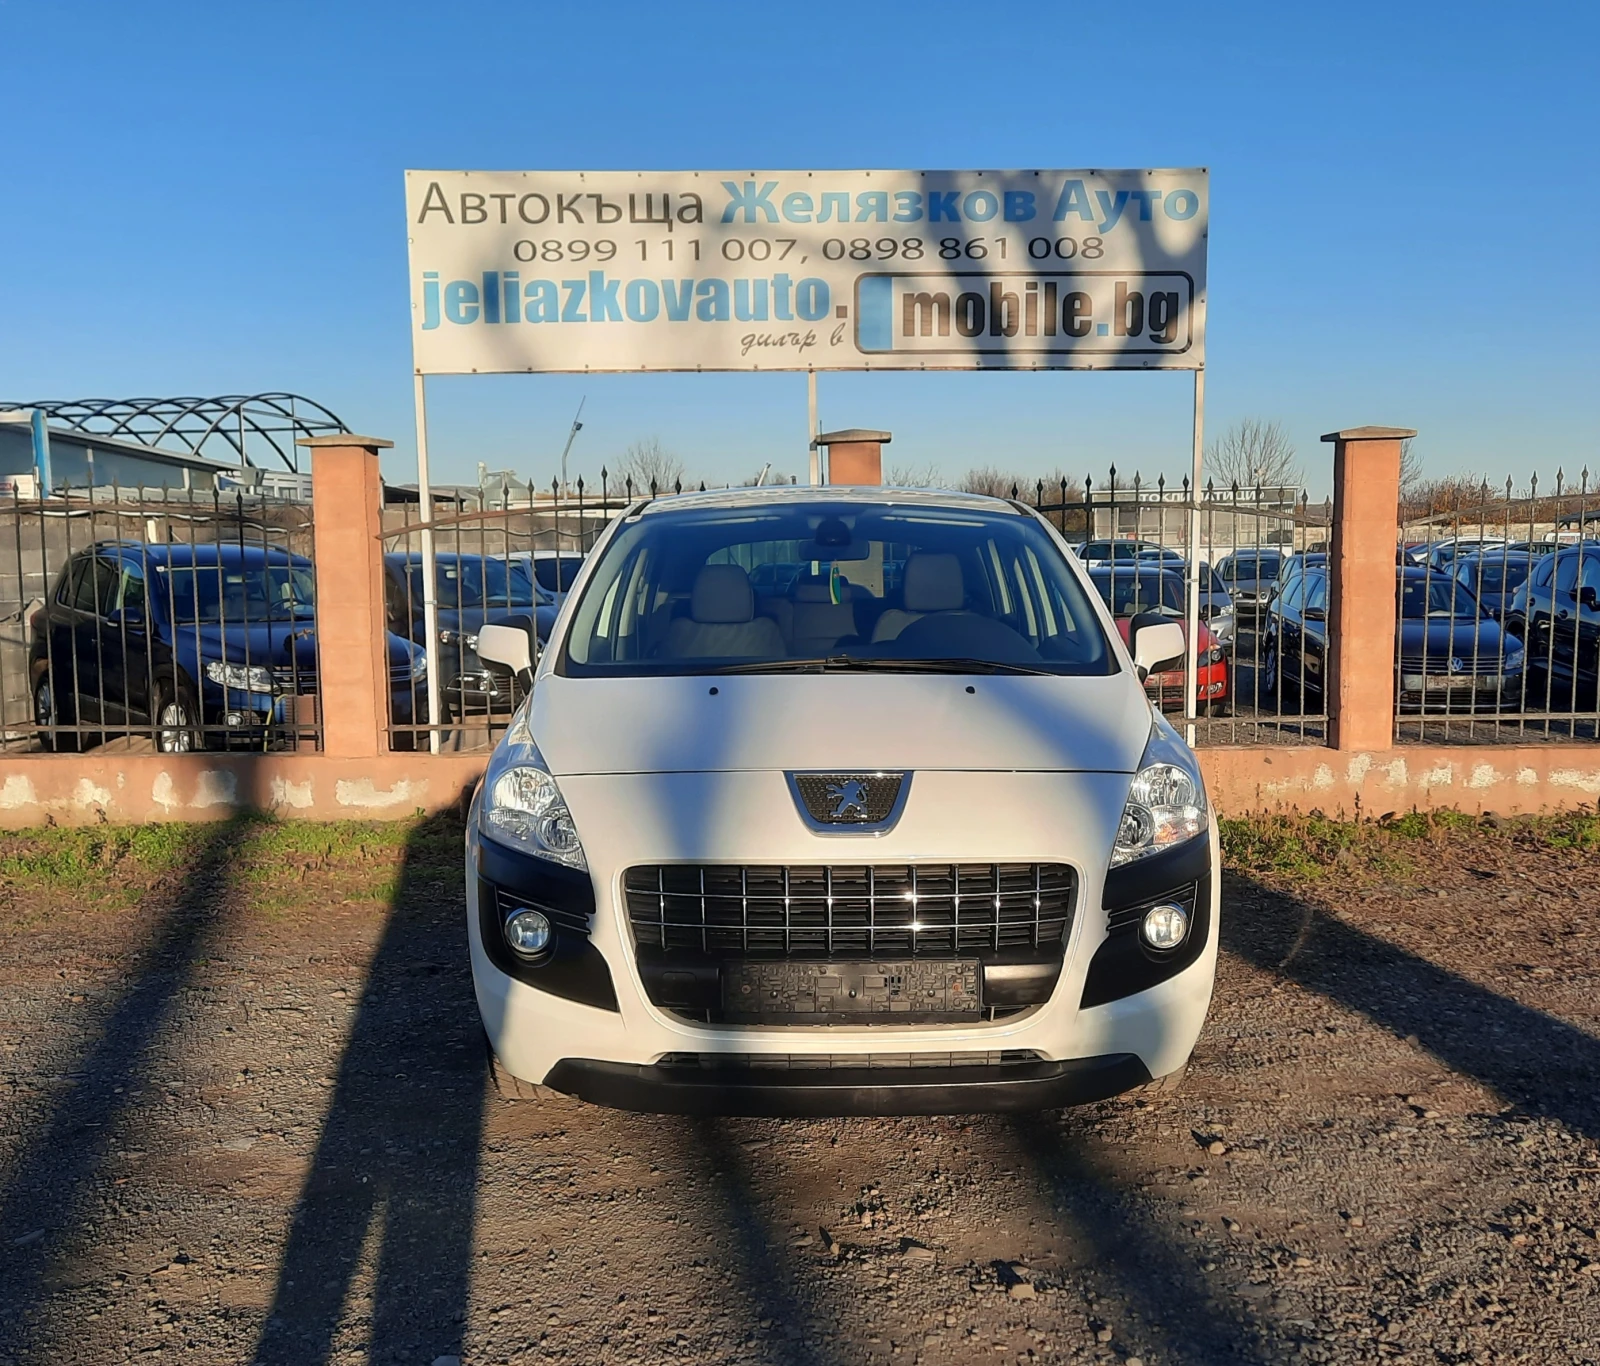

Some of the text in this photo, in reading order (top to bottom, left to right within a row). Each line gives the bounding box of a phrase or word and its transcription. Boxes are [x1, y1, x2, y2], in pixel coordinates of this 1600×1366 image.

[417, 179, 1200, 234] Автокъща Желязков Ауто
[513, 237, 1105, 264] 0899 111 007, 0898 861 008
[902, 281, 1180, 344] mobile.bg
[741, 329, 817, 356] дилър
[1139, 490, 1256, 503] ТОКЛИАТИЦИ
